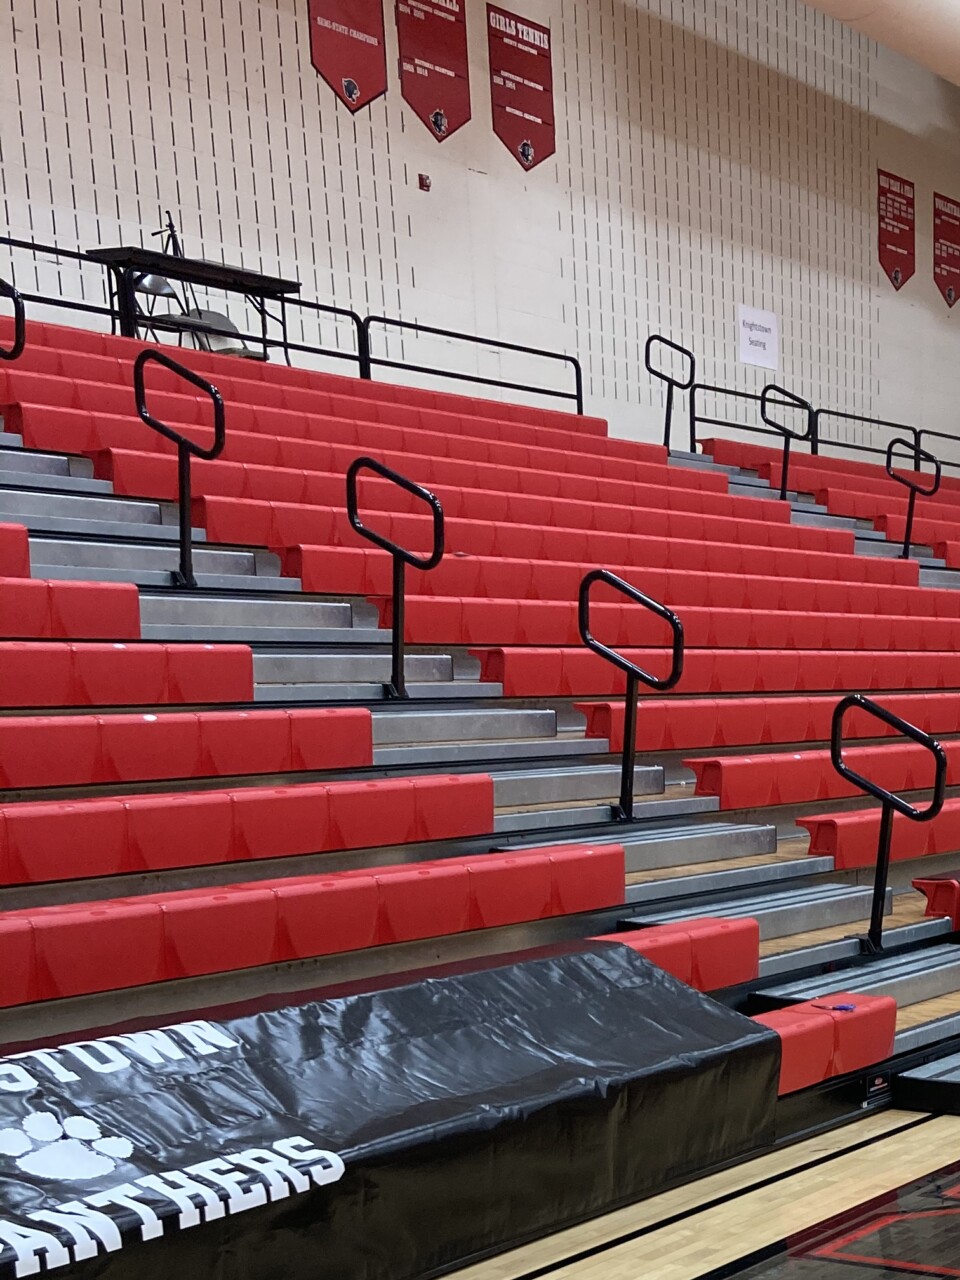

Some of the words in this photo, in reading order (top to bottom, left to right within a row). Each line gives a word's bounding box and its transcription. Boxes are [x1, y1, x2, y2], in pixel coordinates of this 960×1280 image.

[316, 16, 349, 36] SEMI-STATE
[349, 28, 379, 46] CHAMPIONS
[489, 11, 516, 36] GIRLS
[516, 22, 549, 50] TENNIS
[742, 319, 772, 335] Knightstown
[748, 336, 767, 351] Seating
[0, 1135, 346, 1279] ANTHERS
